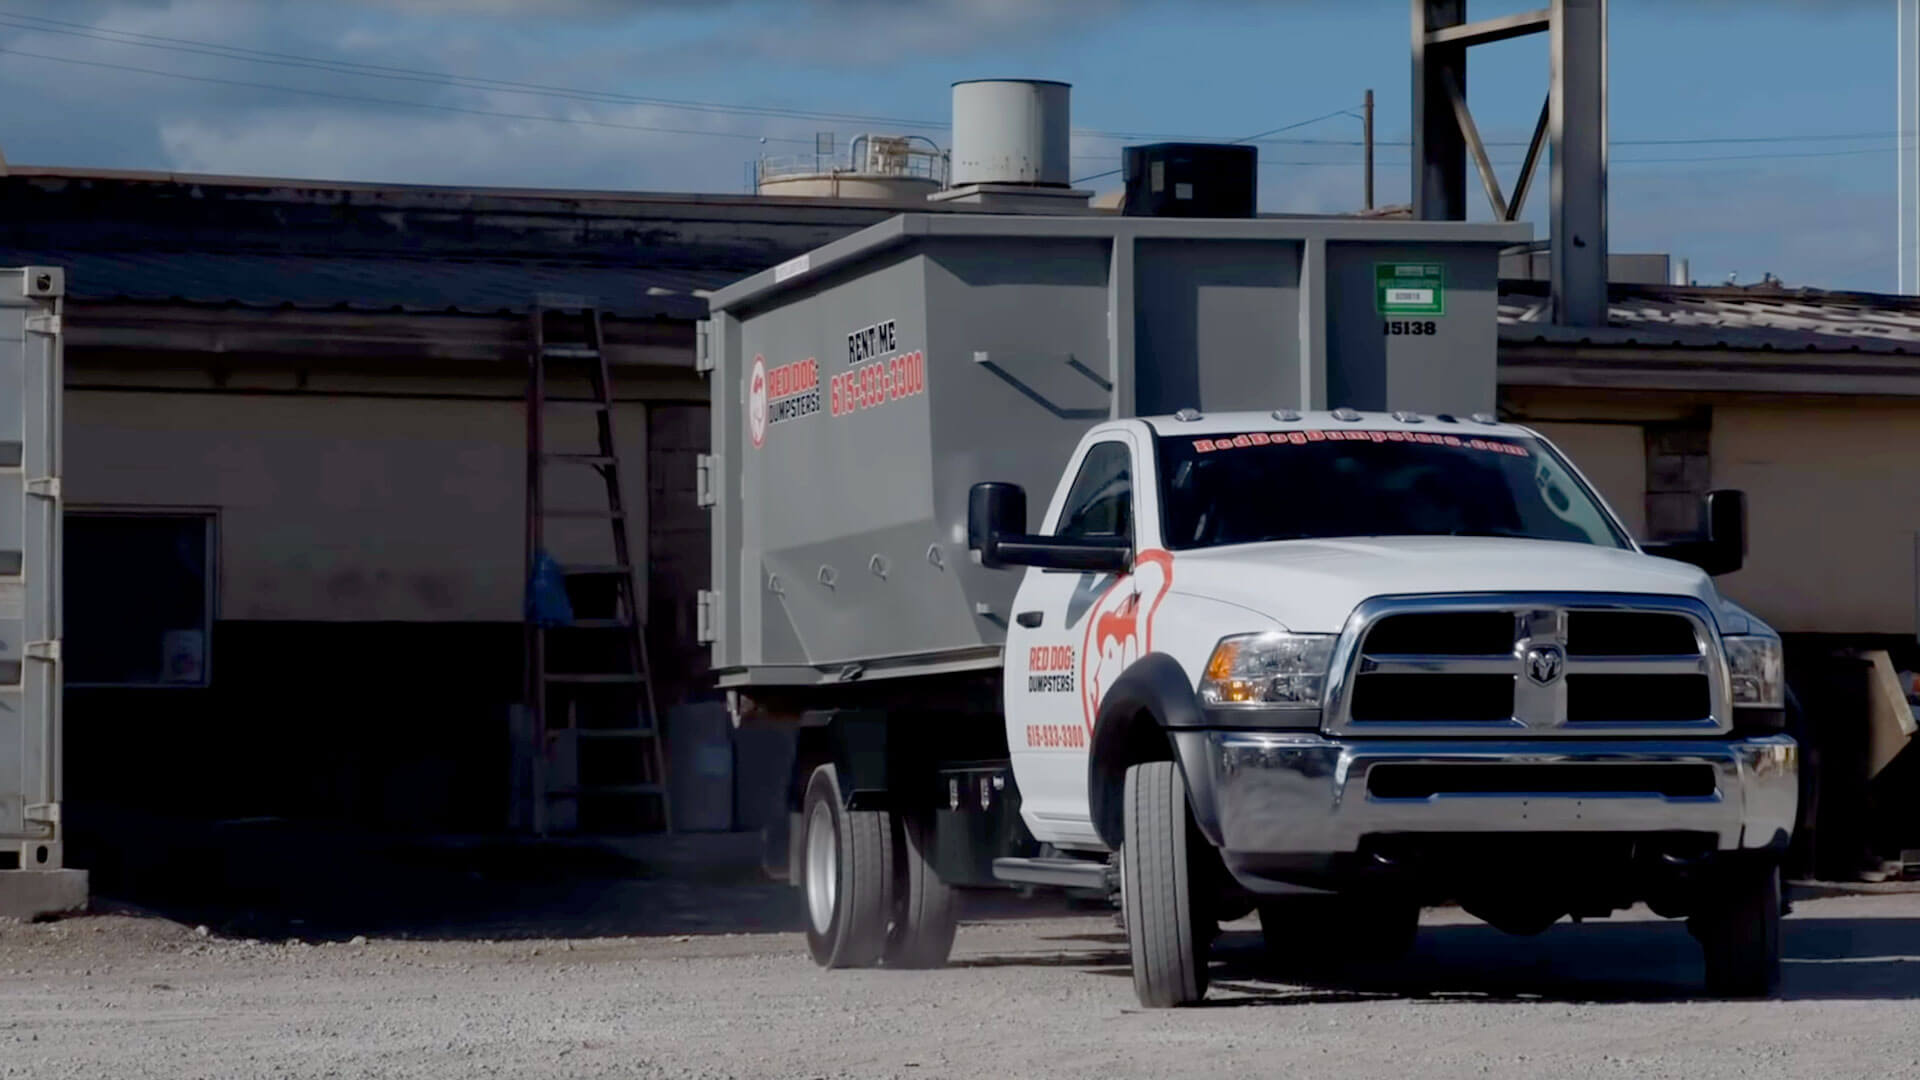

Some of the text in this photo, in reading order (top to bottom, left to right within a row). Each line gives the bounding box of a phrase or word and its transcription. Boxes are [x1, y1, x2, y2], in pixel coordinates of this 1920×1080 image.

[849, 319, 896, 364] RENT ME
[1384, 321, 1436, 336] 15138
[768, 364, 790, 398] RED
[792, 358, 816, 392] DOG
[831, 350, 924, 417] 615-933-3300
[768, 393, 818, 424] DUMPSTERS
[1192, 430, 1529, 457] RedDogDumpsters.com
[1029, 645, 1072, 671] RED DOG
[1029, 675, 1070, 692] DUMPSTERS
[1027, 724, 1084, 748] 615-933-3300
